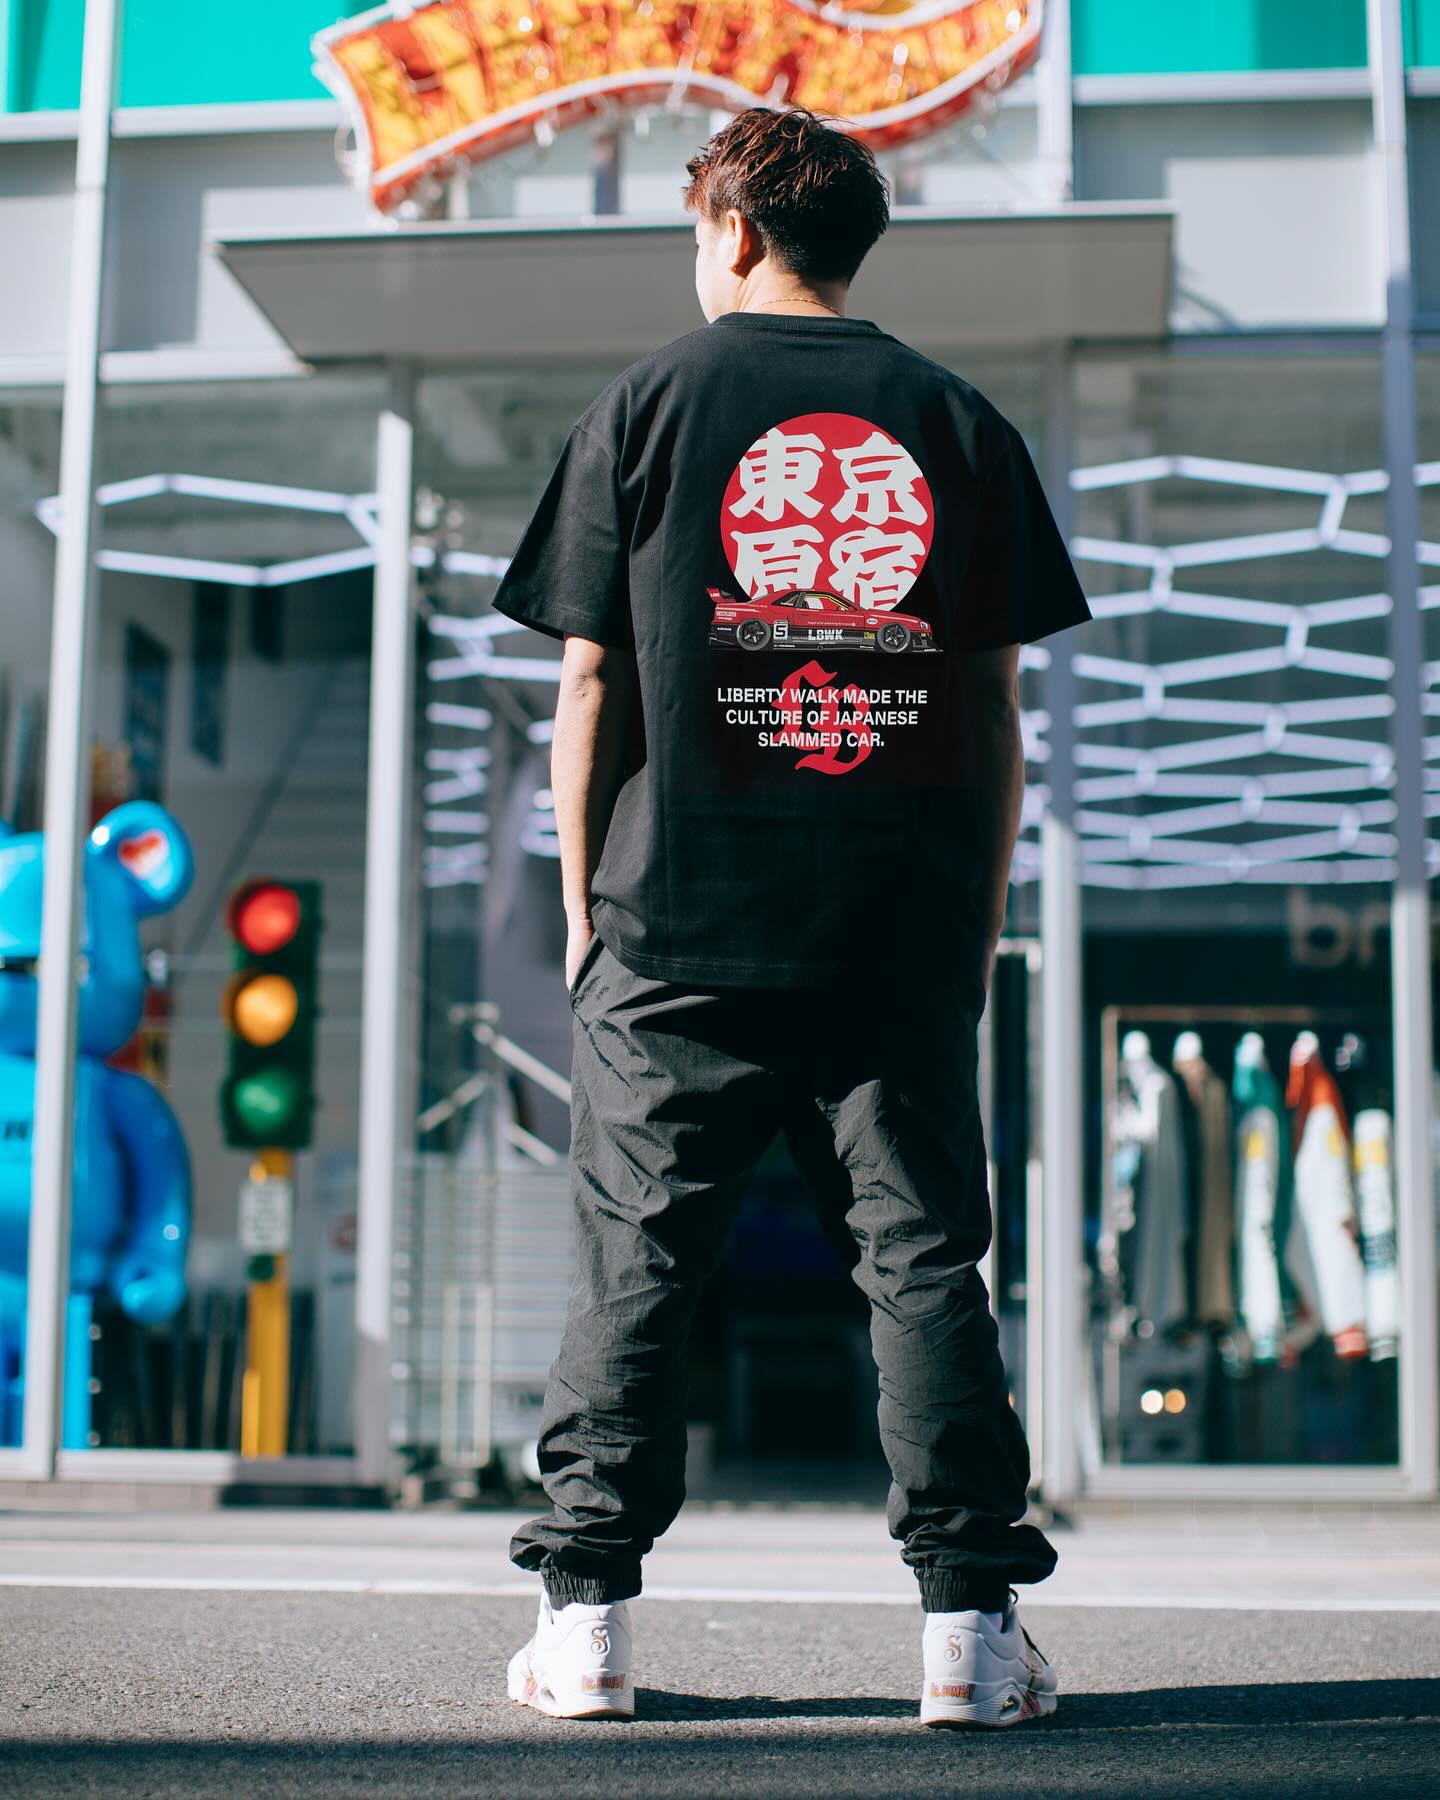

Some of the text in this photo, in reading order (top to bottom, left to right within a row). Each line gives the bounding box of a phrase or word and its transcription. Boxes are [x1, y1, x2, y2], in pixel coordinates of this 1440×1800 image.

[729, 427, 928, 526] 東京
[729, 523, 926, 612] 原宿
[775, 624, 788, 638] 5
[807, 629, 844, 641] LBWK
[718, 687, 928, 704] LIBERTY WALK MADE THE
[725, 709, 919, 726] CULTURE OF JAPANESE
[757, 731, 885, 747] SLAMMED CAR.
